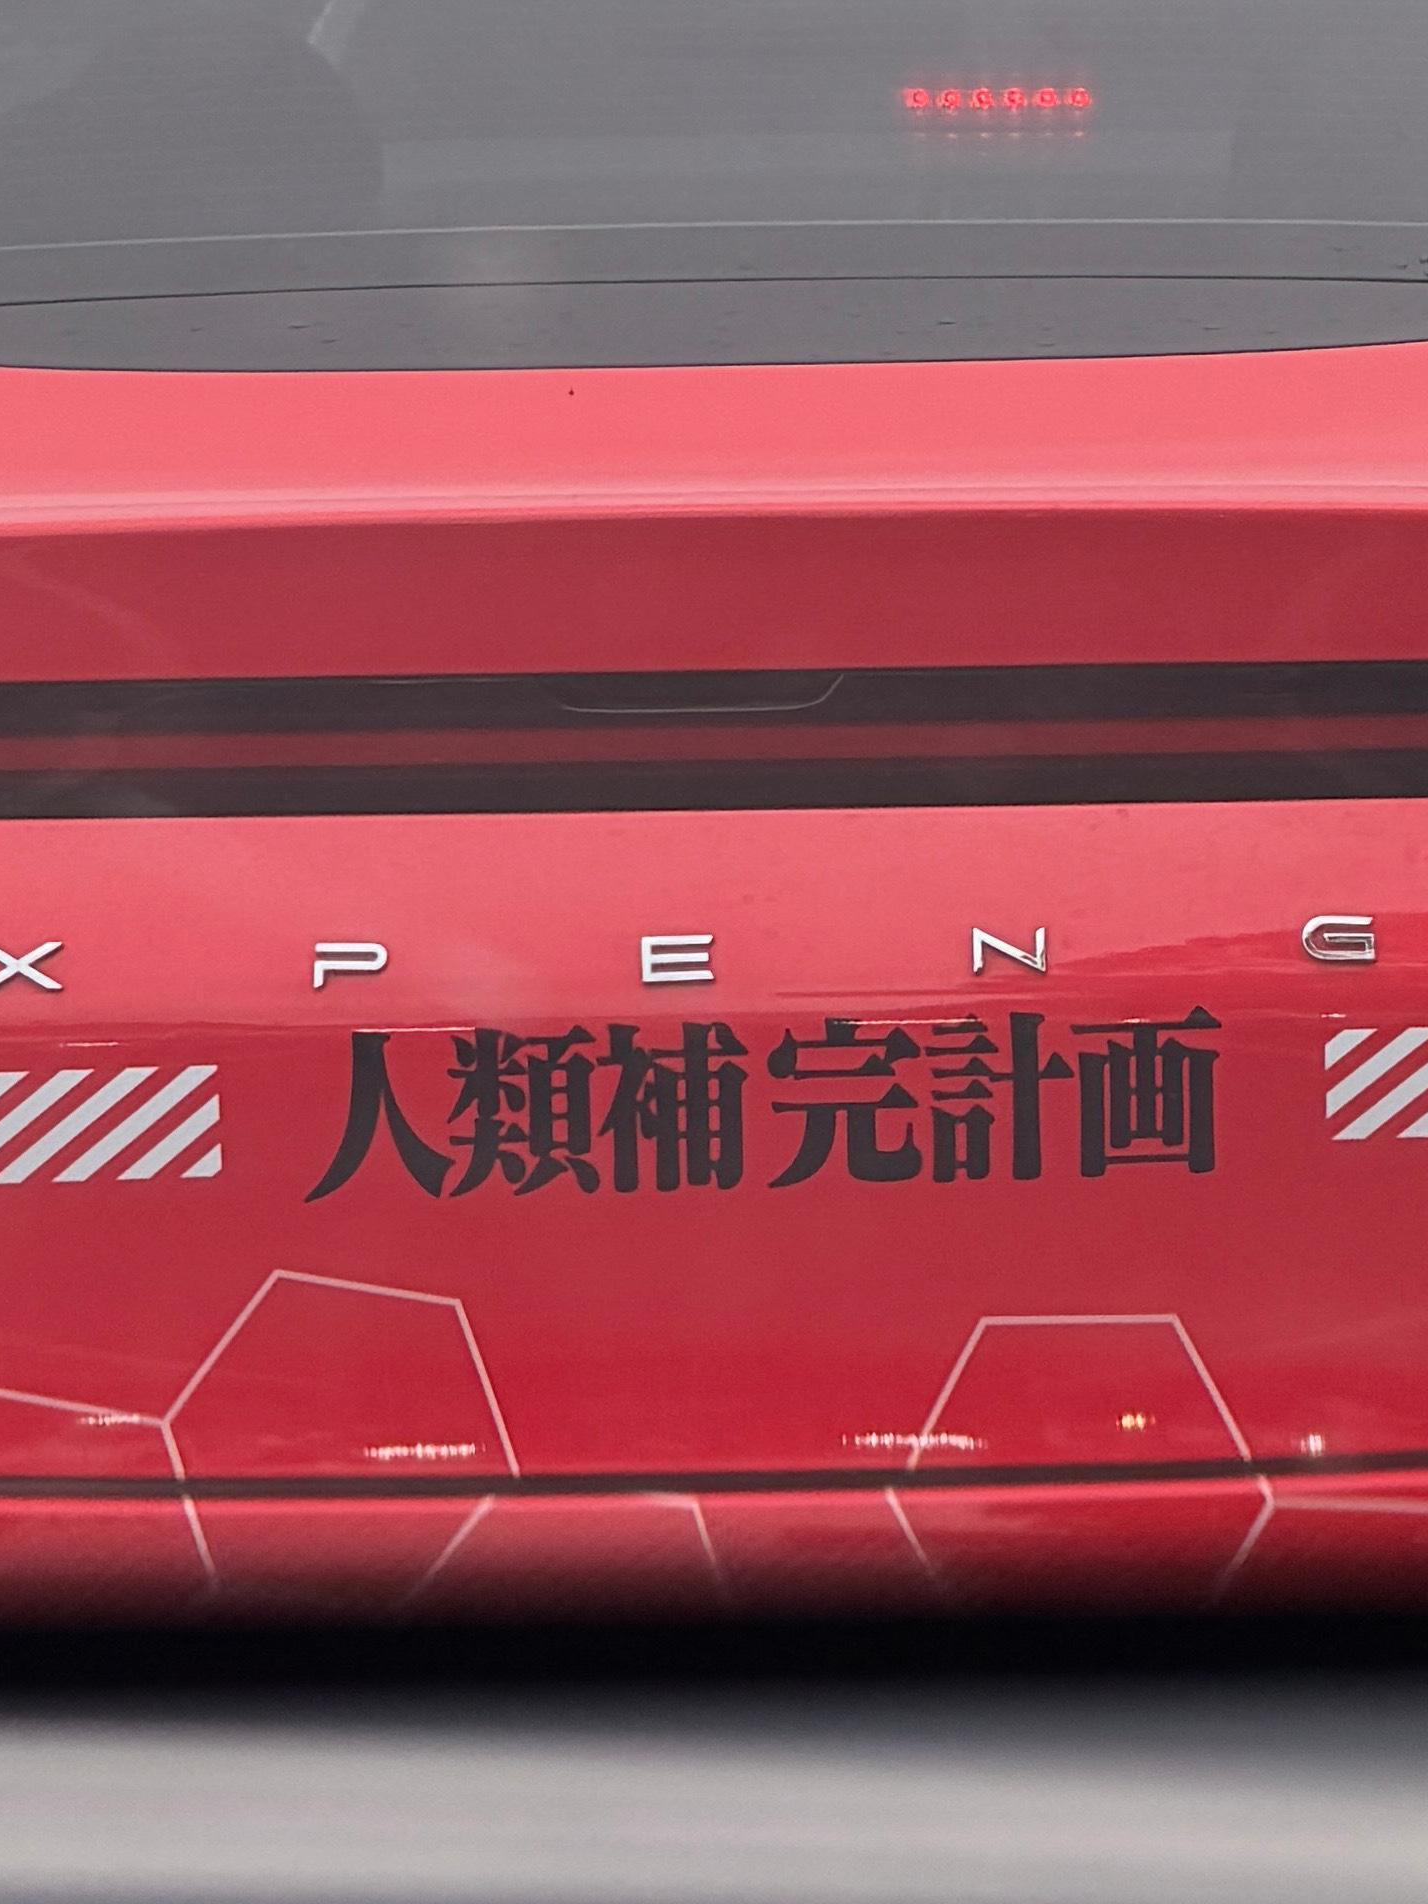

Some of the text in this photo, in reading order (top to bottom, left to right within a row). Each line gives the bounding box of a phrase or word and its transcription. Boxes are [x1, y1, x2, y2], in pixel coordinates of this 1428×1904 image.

[305, 1005, 1222, 1202] 人類補完計画
